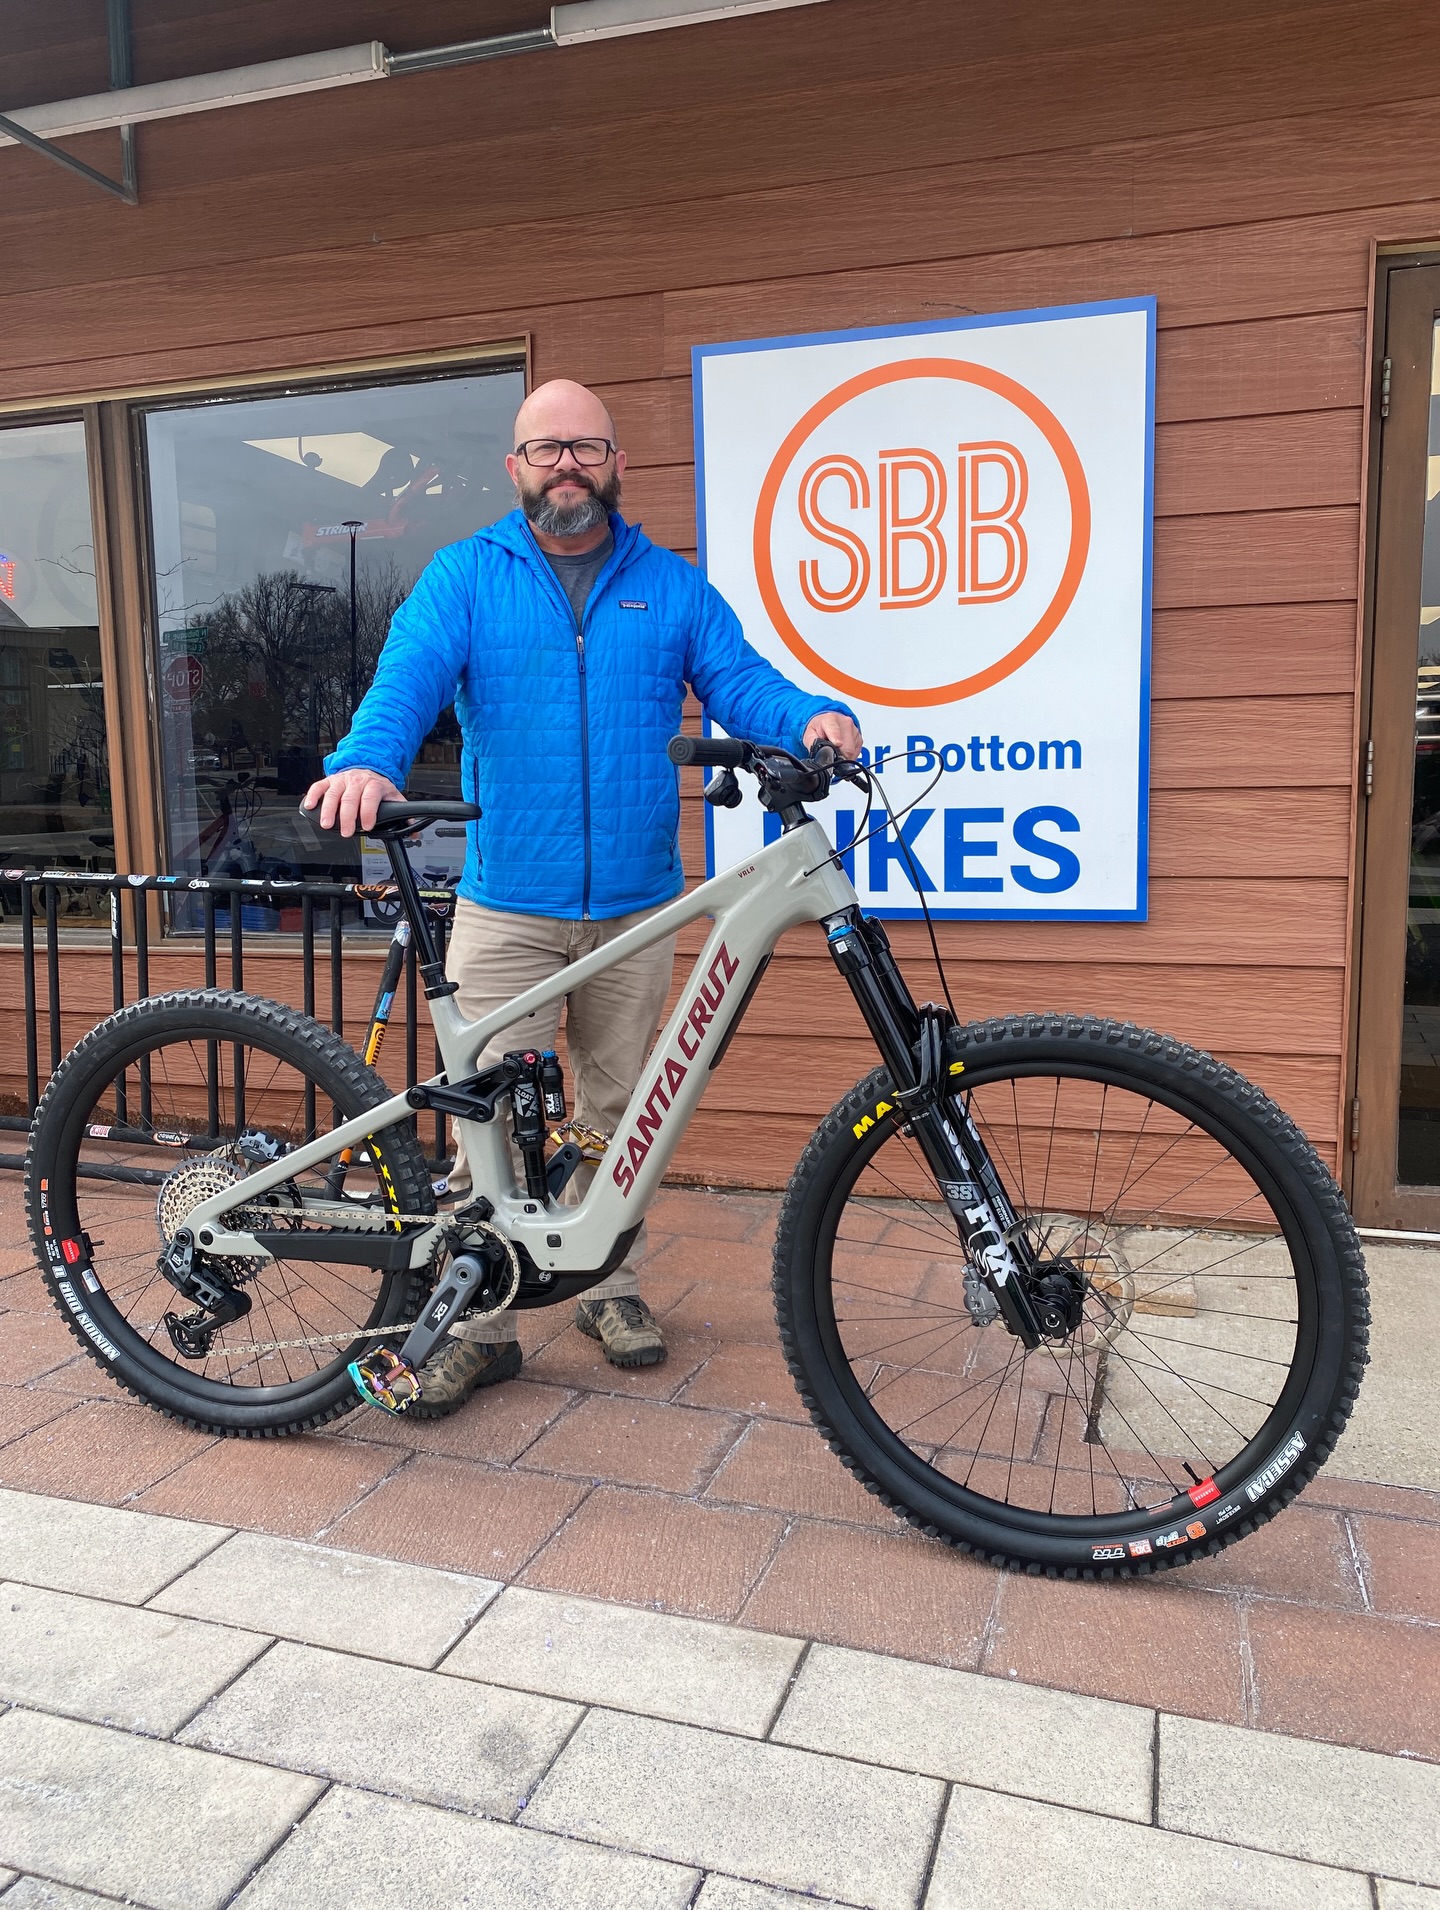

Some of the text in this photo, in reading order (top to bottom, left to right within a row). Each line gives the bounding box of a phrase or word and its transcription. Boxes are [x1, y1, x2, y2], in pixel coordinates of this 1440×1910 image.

[798, 440, 1029, 613] SBB
[906, 735, 1082, 773] Bottom
[612, 940, 740, 1199] SANTA CRUZ
[963, 1199, 1021, 1288] FOX
[58, 1281, 84, 1314] DHR
[76, 1312, 121, 1362] MINION
[1244, 1430, 1308, 1503] ASSEGAI
